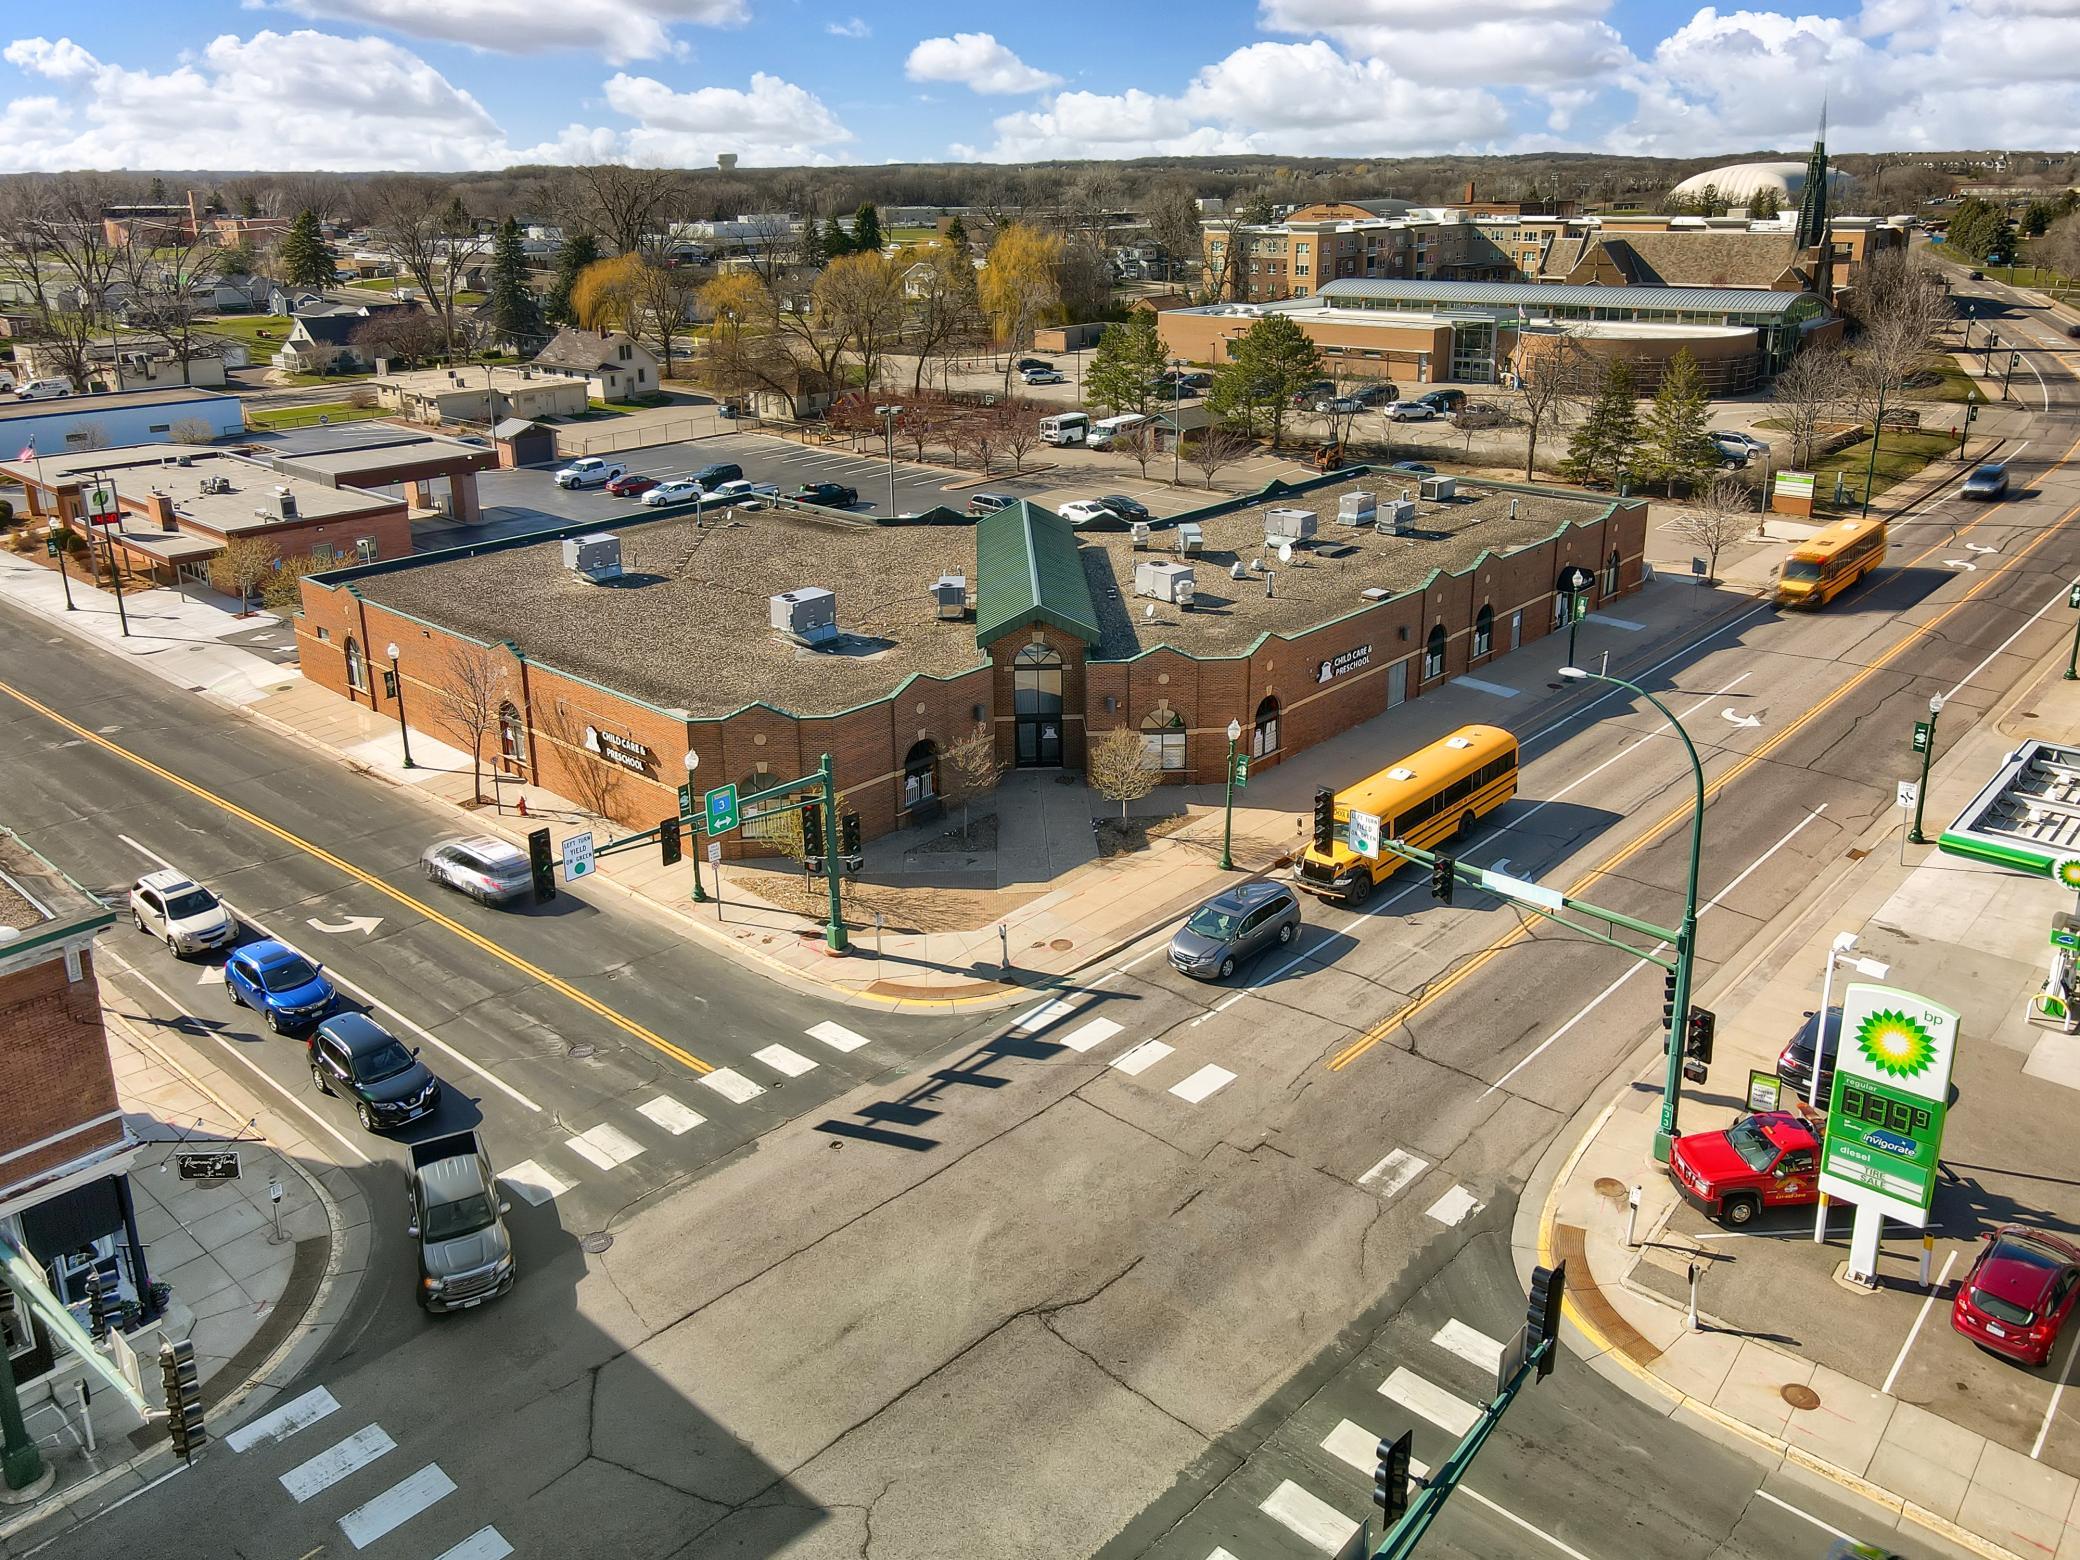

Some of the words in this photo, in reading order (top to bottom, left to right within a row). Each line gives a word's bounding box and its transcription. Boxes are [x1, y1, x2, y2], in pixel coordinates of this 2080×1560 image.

[1334, 653, 1352, 667] CHILD
[1352, 646, 1368, 660] CARE
[1335, 655, 1370, 677] PRESCHOOL
[602, 731, 621, 746] CHILD
[621, 739, 640, 755] CARE
[606, 747, 645, 771] PRESCHOOL
[718, 800, 725, 810] 3
[563, 840, 576, 849] LEFT
[578, 836, 591, 844] TURN
[570, 845, 587, 856] YIELD
[575, 853, 592, 861] GREEN
[1924, 1010, 1943, 1026] bp
[1846, 1079, 1878, 1092] regular
[1840, 1146, 1871, 1162] diesel
[1864, 1165, 1886, 1180] TIRE
[1860, 1174, 1887, 1189] SALE
